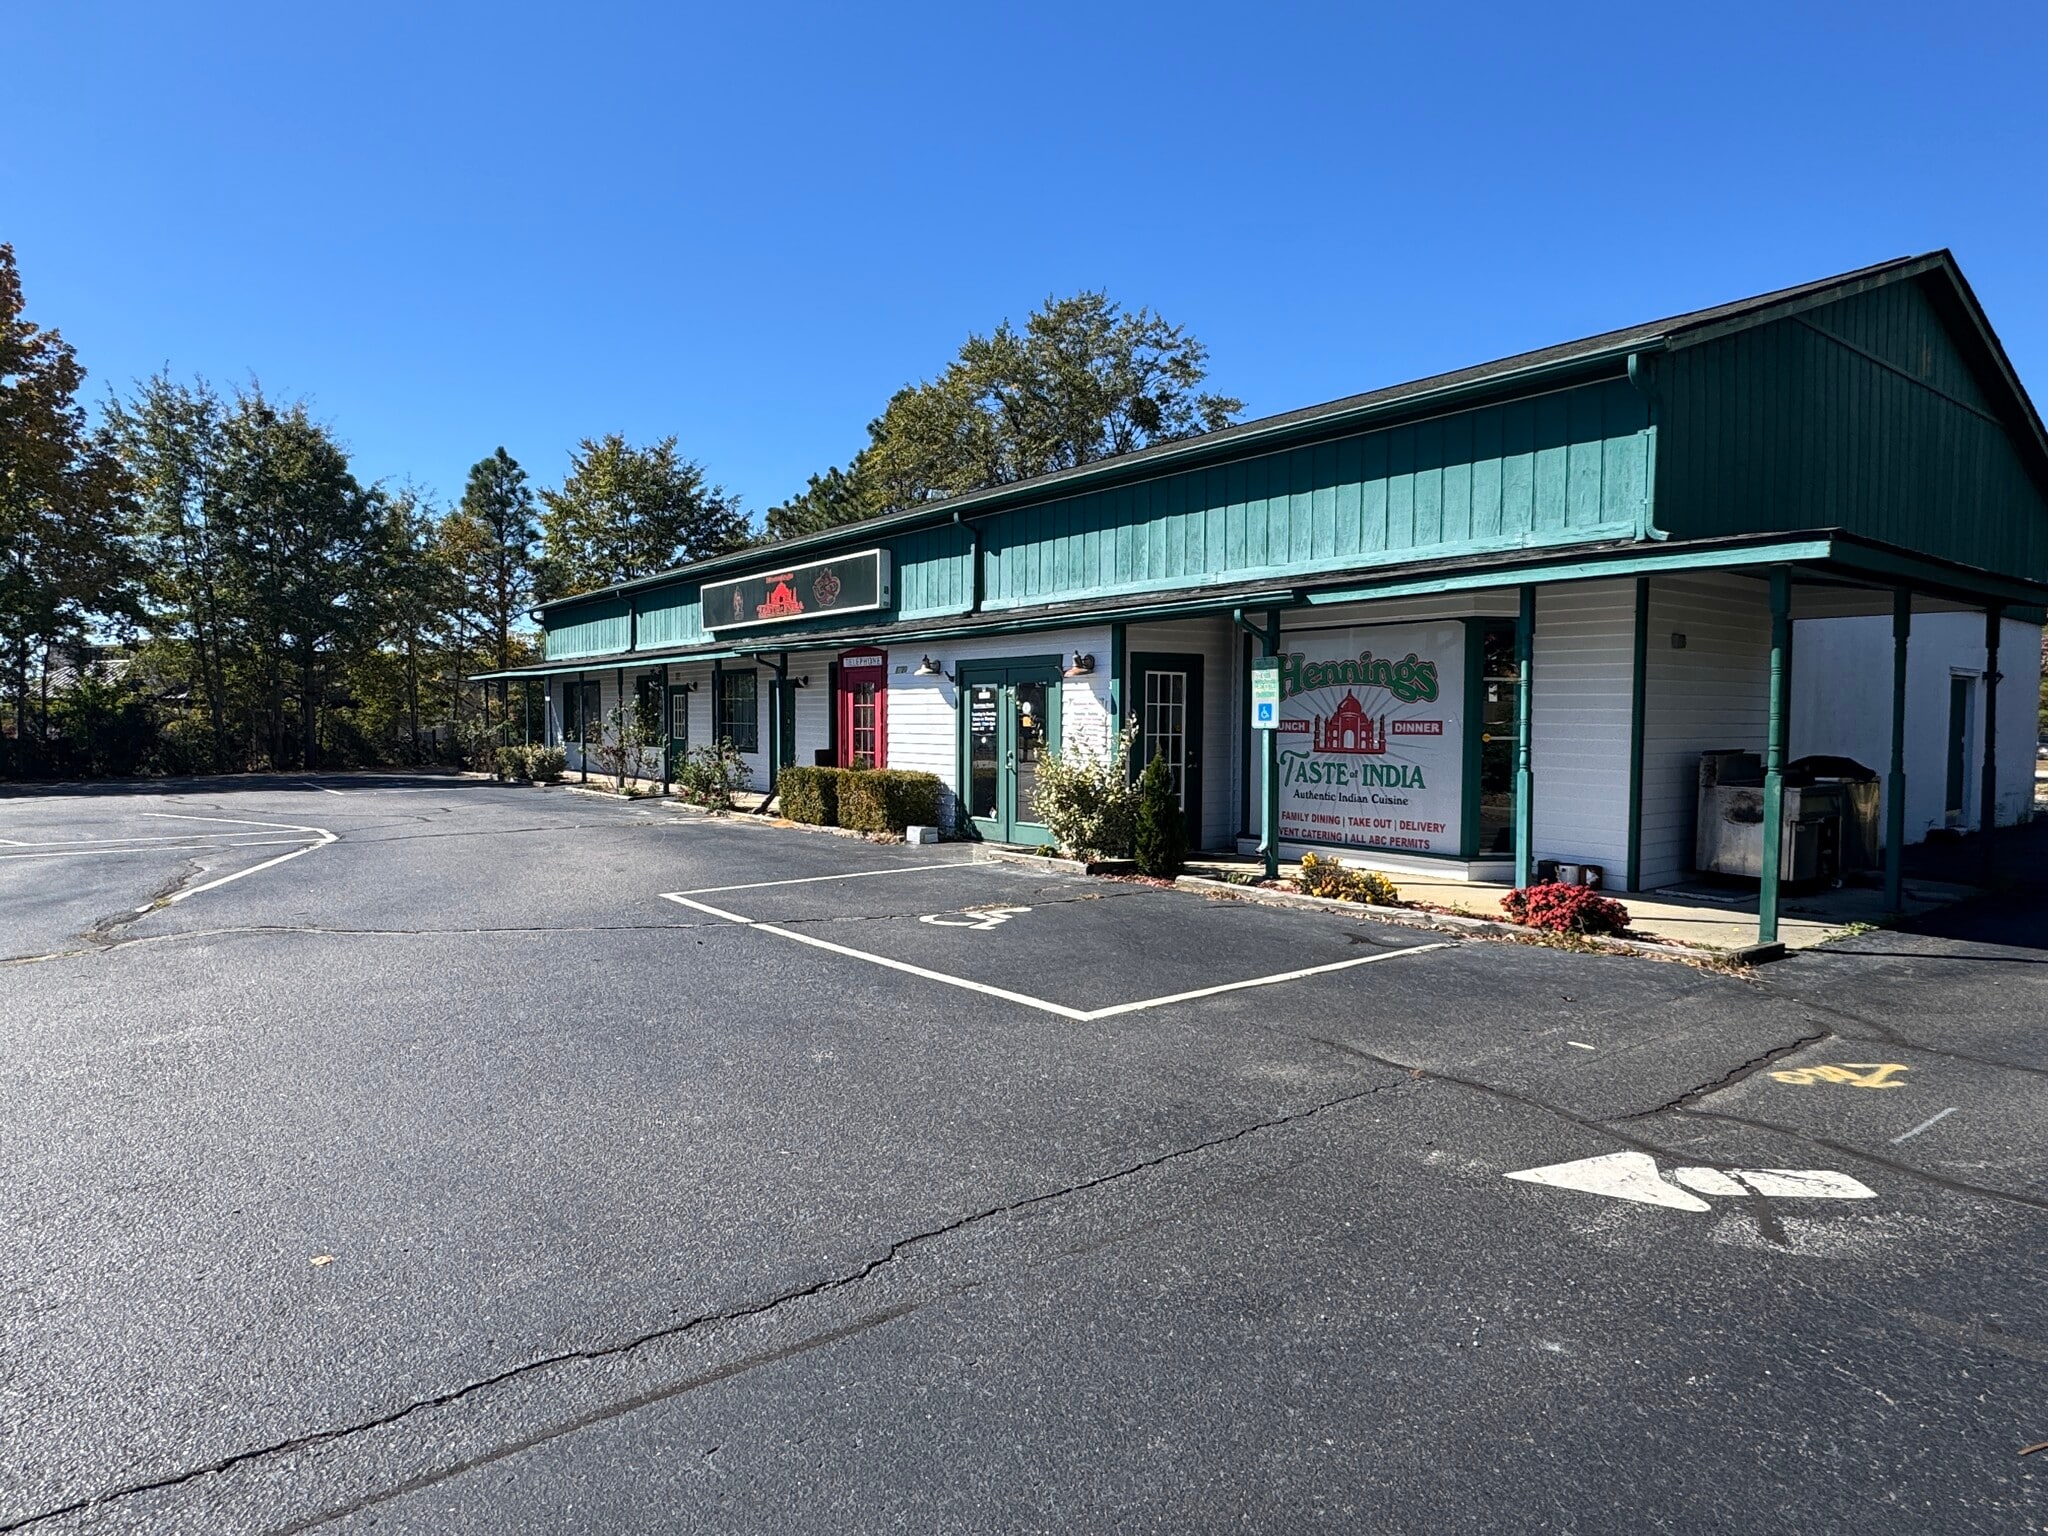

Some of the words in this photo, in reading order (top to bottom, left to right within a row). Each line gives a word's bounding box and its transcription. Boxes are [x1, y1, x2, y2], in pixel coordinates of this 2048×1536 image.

[1279, 721, 1305, 731] UNCH
[1395, 722, 1439, 733] DINNER
[1280, 750, 1349, 787] TASTE
[1362, 765, 1426, 789] INDIA
[1293, 789, 1336, 801] Authentic
[1338, 792, 1368, 804] Indian
[1371, 794, 1409, 805] Cuisine
[1281, 811, 1309, 821] FAMILY
[1311, 814, 1340, 825] DINING
[1348, 817, 1371, 827] TAKE
[1373, 819, 1392, 829] OUT
[1399, 820, 1446, 833] DELIVERY
[1279, 827, 1300, 836] VENT
[1301, 829, 1342, 841] CATERING
[1350, 833, 1366, 843] ALL
[1368, 835, 1388, 845] ABC
[1390, 837, 1430, 849] PERMITS
